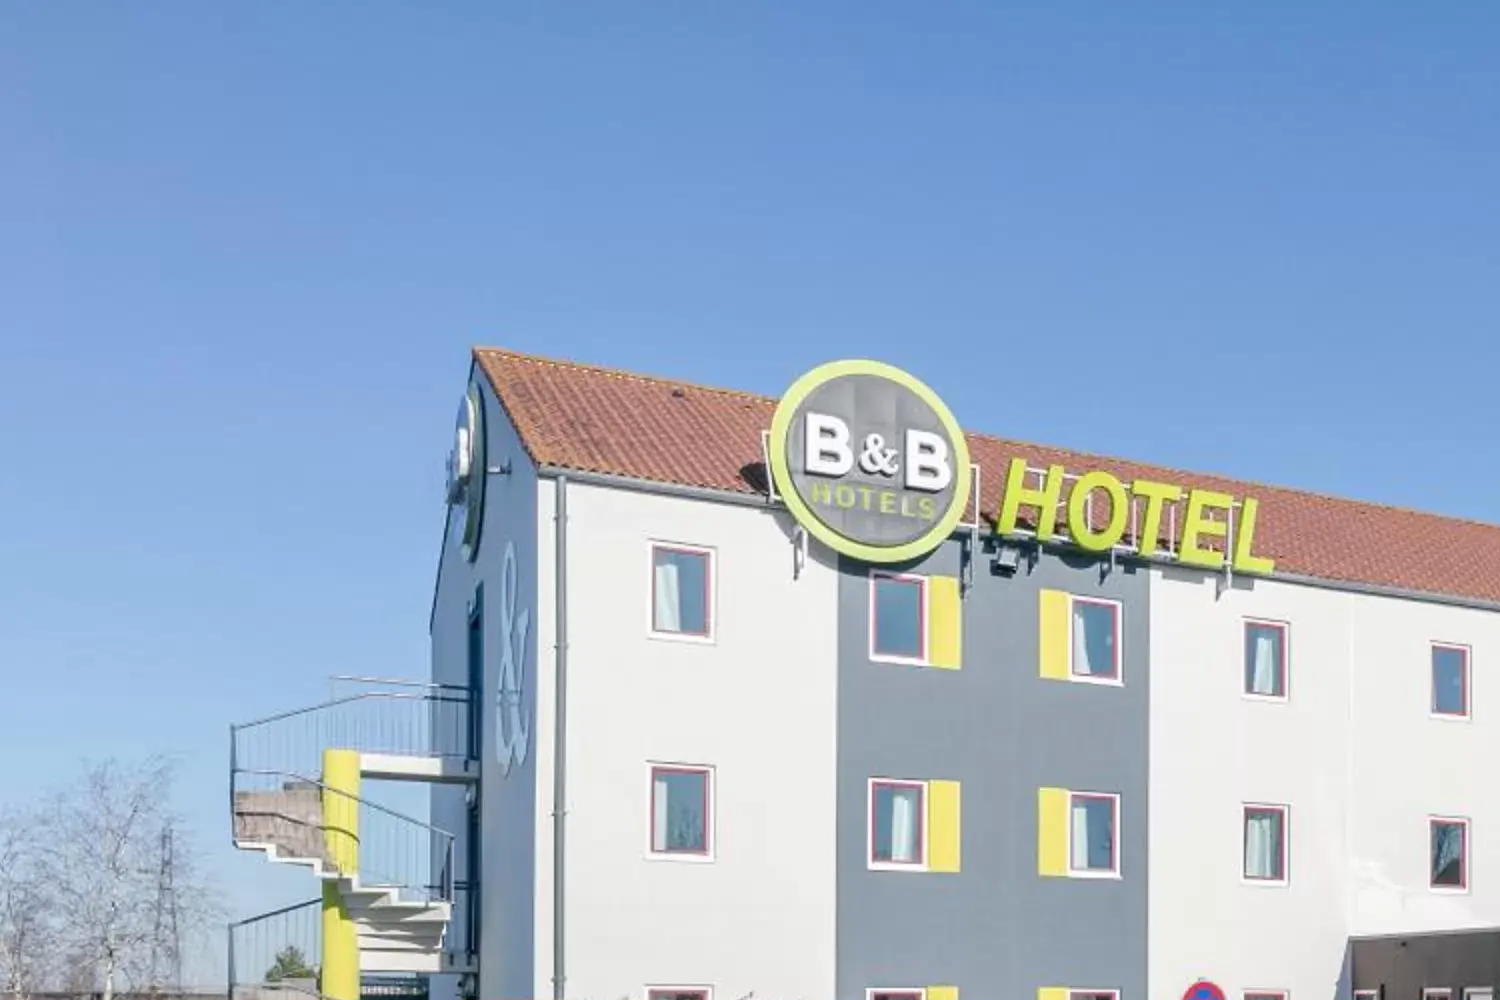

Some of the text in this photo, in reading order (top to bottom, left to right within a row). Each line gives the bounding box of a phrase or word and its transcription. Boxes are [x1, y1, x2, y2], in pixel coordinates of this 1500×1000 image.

[803, 411, 952, 494] B&B
[809, 483, 936, 520] HOTELS
[997, 457, 1275, 575] HOTEL
